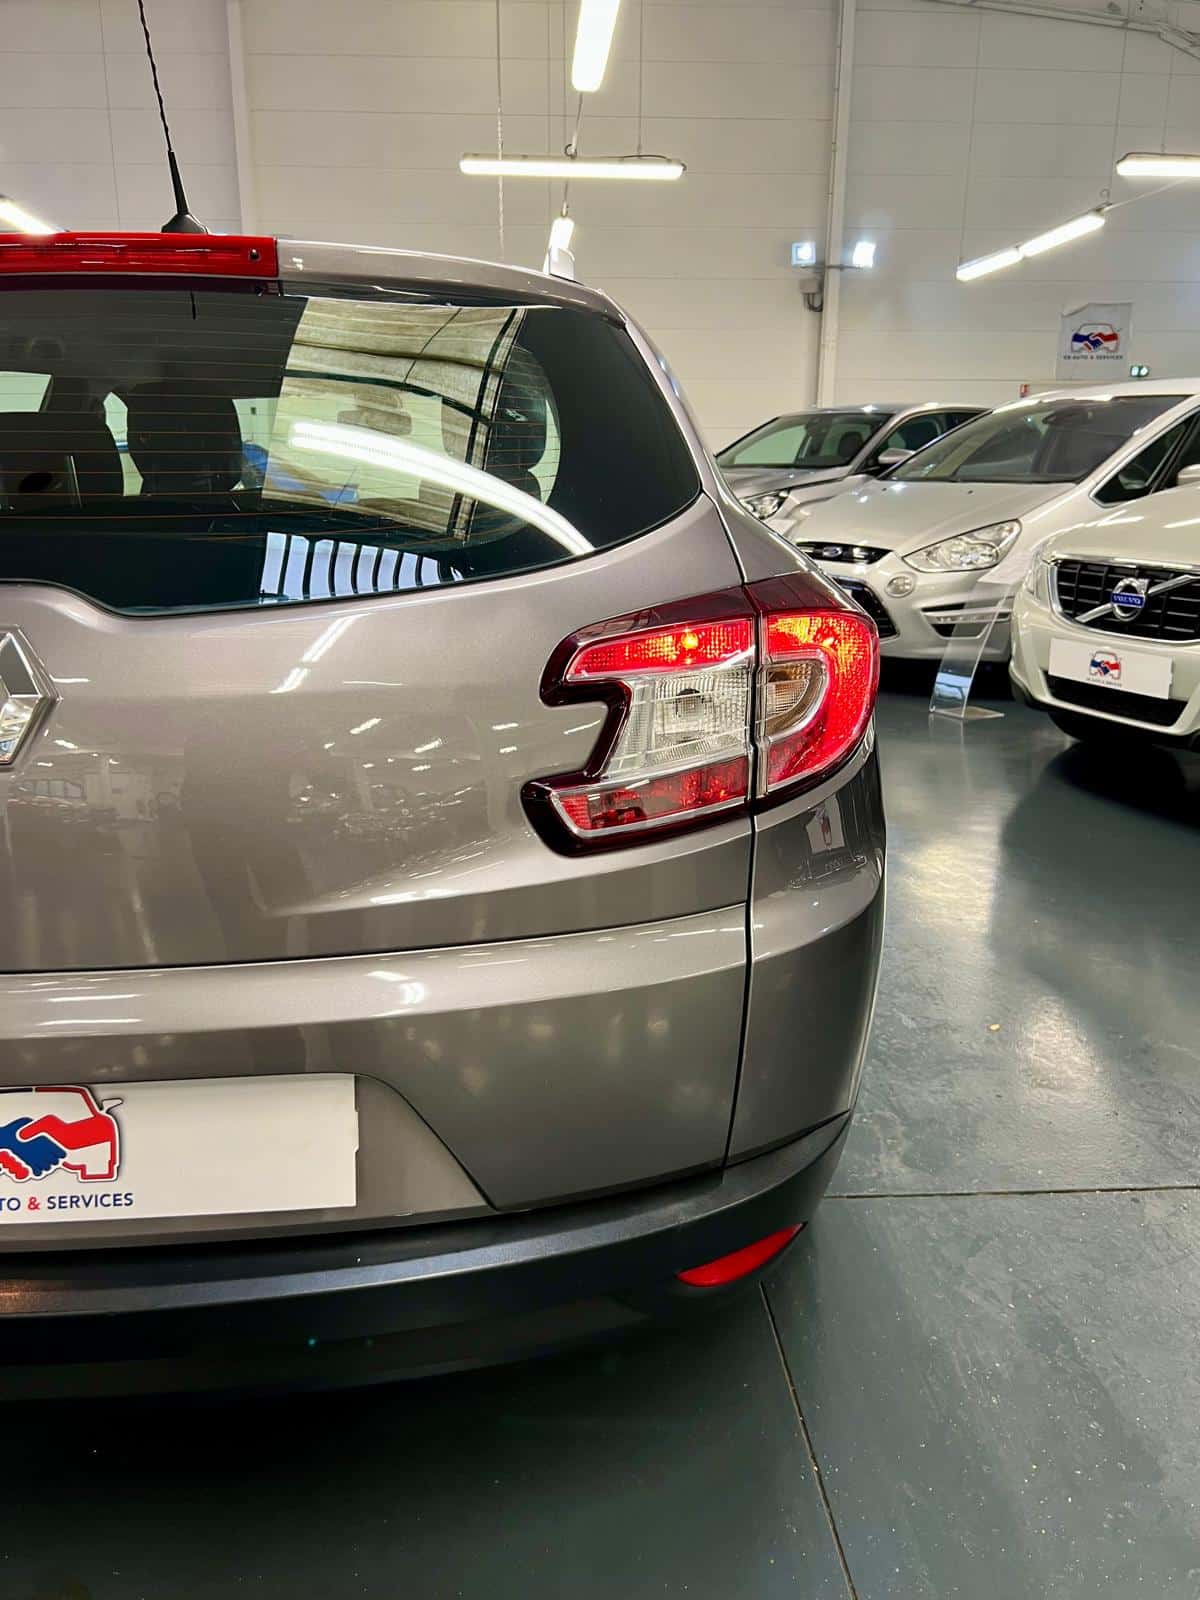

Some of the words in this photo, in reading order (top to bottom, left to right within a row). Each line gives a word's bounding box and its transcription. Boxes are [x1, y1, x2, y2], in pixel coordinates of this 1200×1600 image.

[1113, 594, 1141, 605] VOLVO
[27, 1196, 41, 1210] &
[47, 1192, 134, 1210] SERVICES
